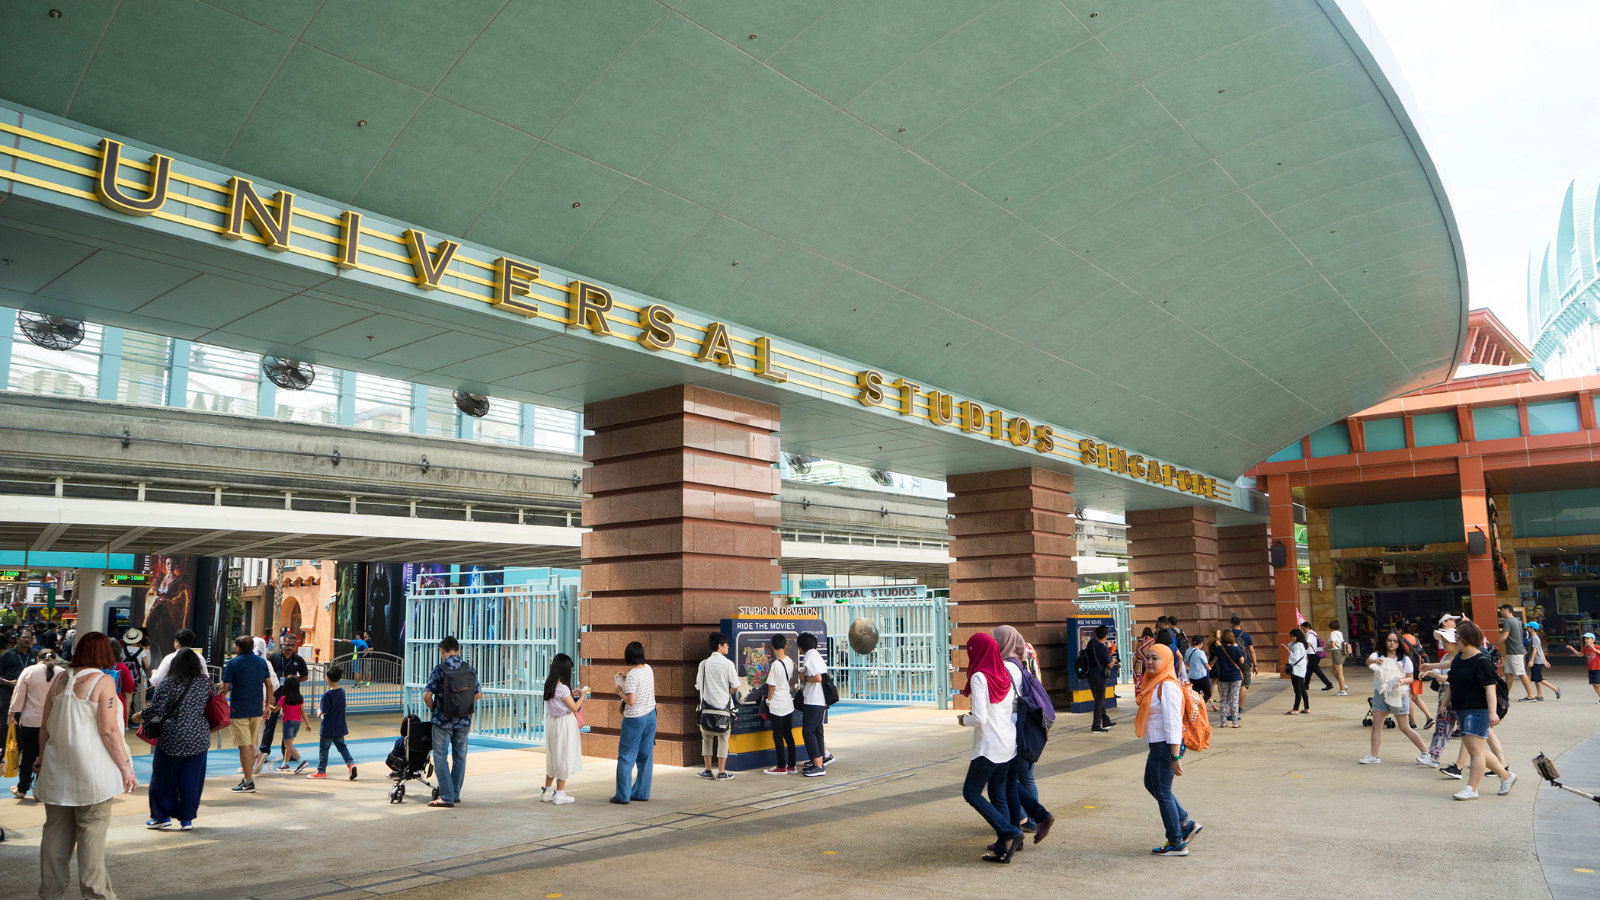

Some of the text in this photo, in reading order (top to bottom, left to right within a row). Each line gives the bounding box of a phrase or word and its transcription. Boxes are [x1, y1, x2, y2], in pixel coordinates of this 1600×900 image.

[95, 137, 1220, 499] UNIVERSAL STUDIOS SINGAPORE
[811, 588, 917, 599] UNIVERSAL STUDIOS
[738, 606, 818, 616] STUDIO INFORMATION
[736, 622, 795, 630] RIDE THE MOVIES
